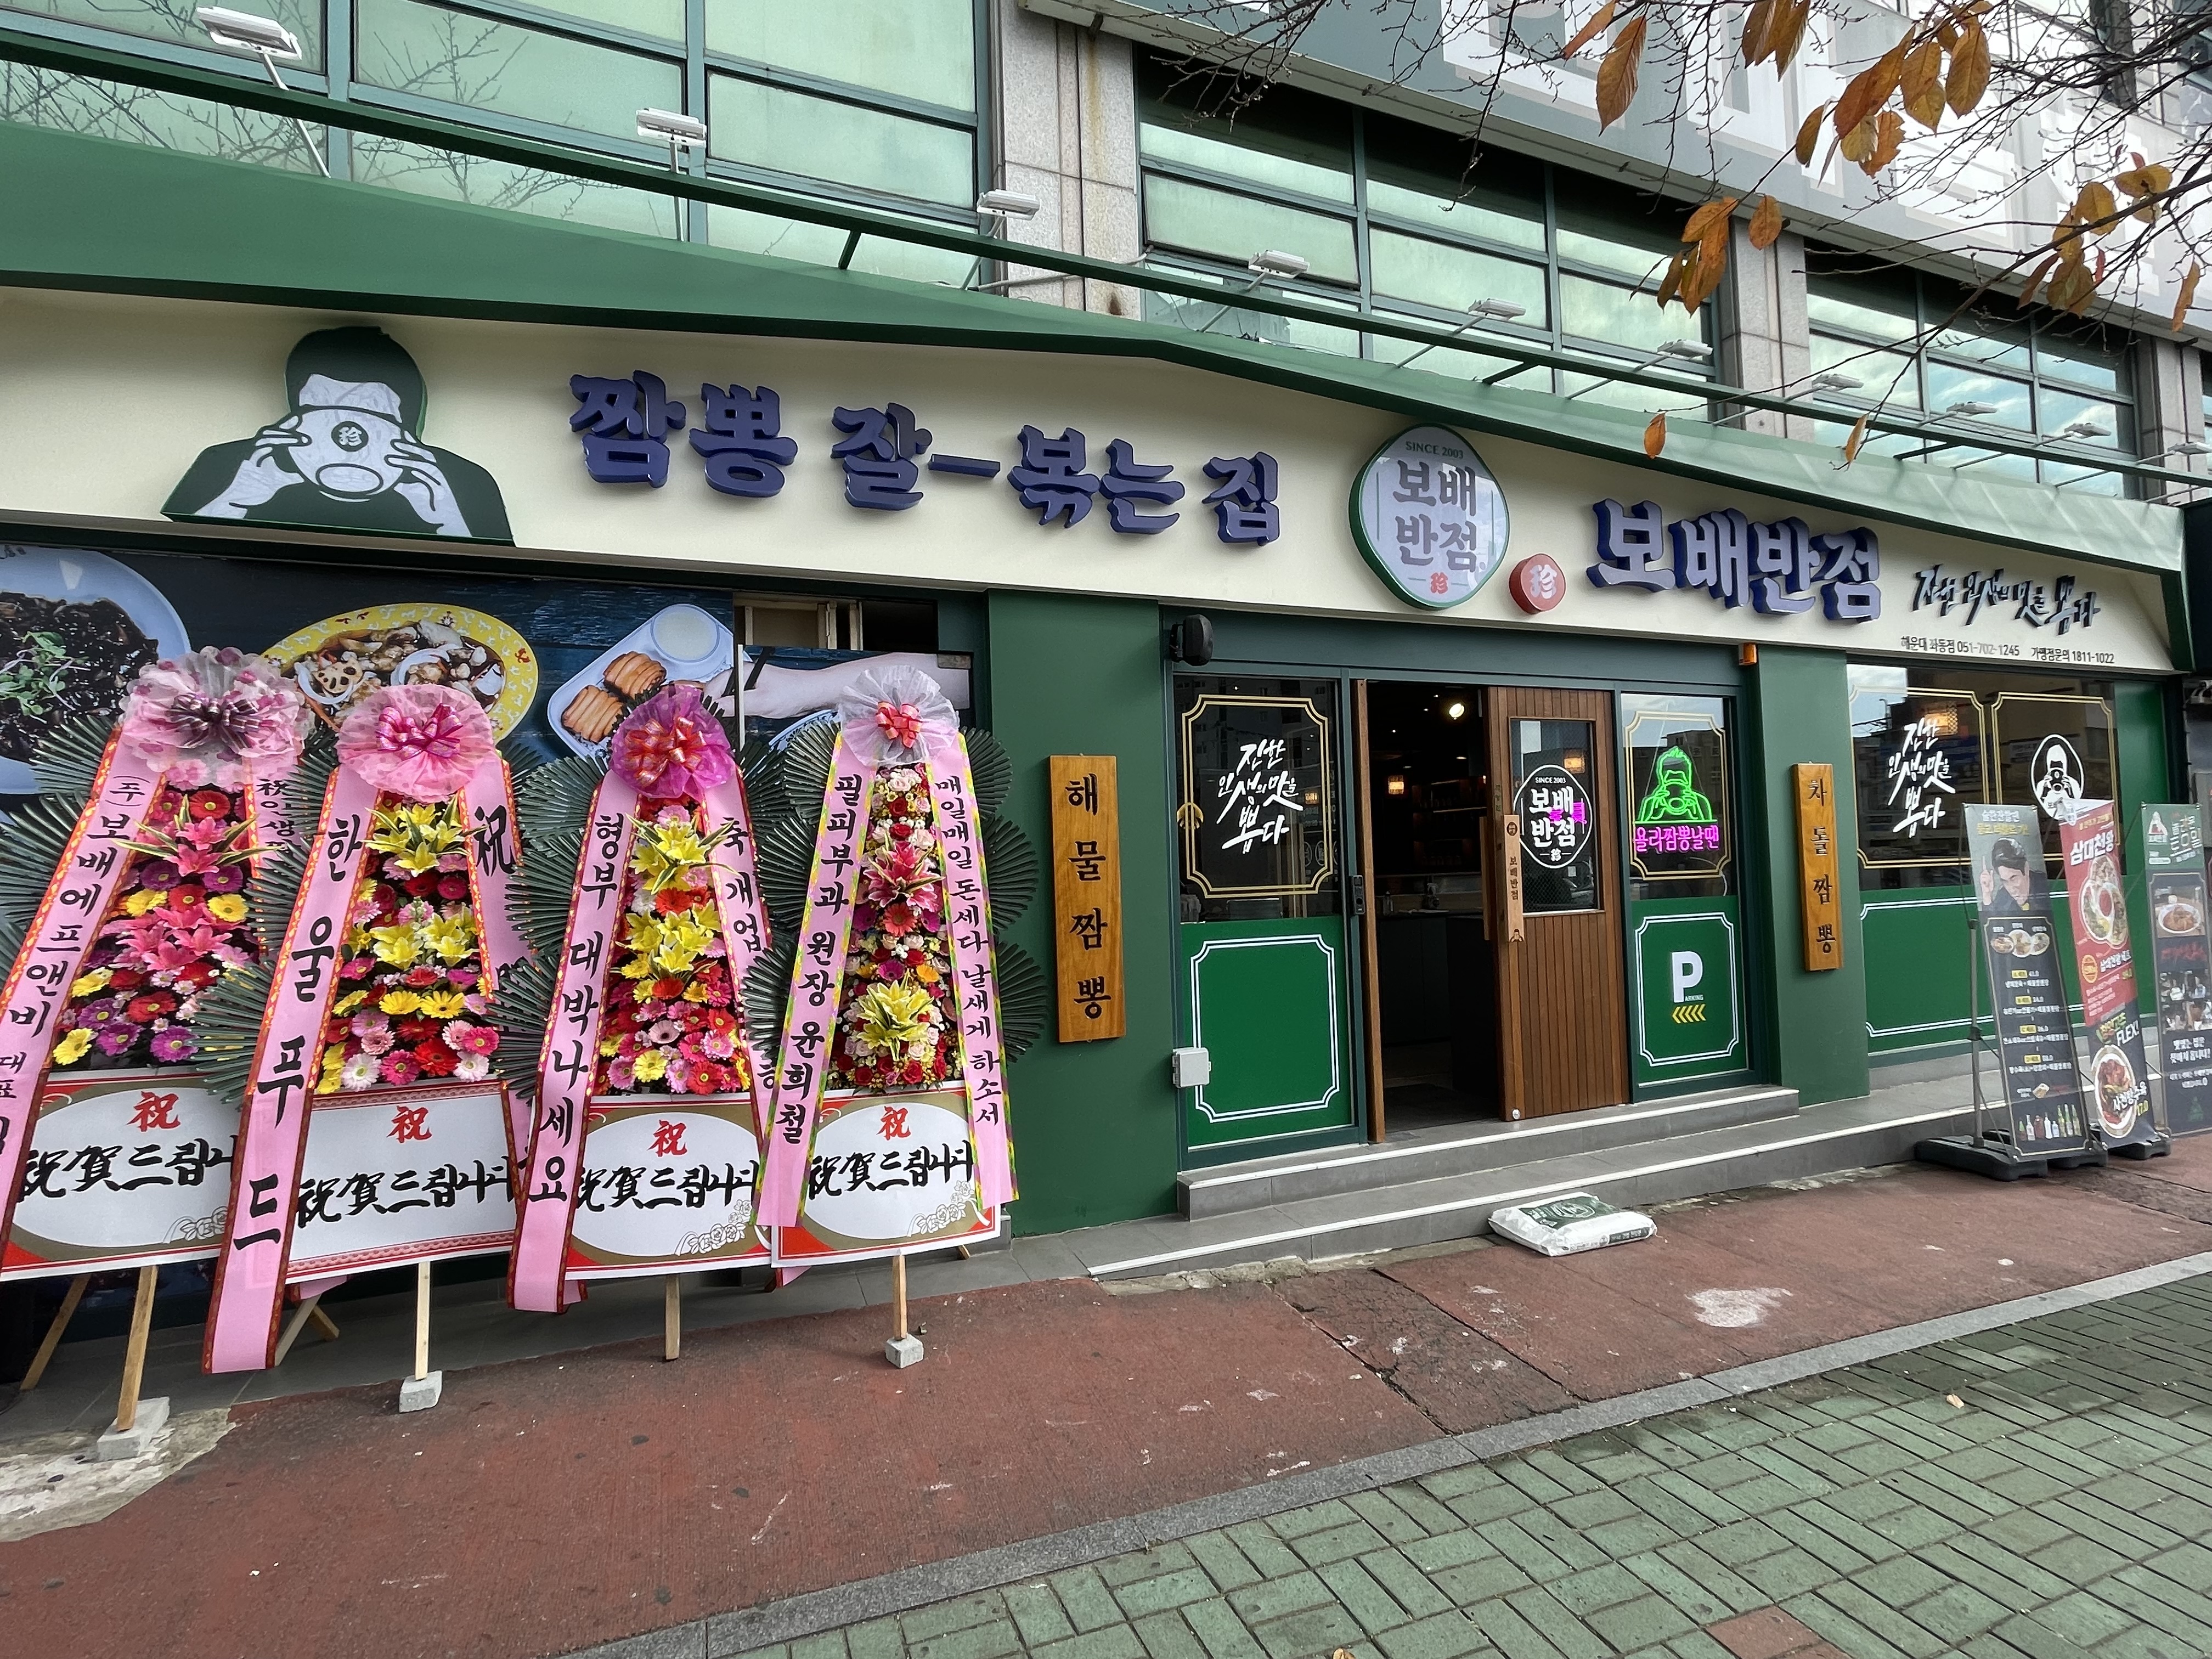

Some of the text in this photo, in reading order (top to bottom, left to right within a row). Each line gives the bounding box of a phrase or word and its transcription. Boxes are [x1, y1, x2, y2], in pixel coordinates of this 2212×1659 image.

[569, 370, 798, 497] 짬뽕
[1201, 452, 1280, 546] 집
[1405, 441, 1464, 460] SINCE 2003
[1393, 460, 1476, 517] 보배
[1395, 514, 1477, 573] 반점
[1586, 498, 1881, 624] 보배반점
[1900, 636, 2114, 664] 해운대 좌동점 051-702-1245 가맹점문의 1811-1022
[1236, 738, 1286, 776] 진한
[1902, 717, 1940, 757] 진한
[1216, 770, 1304, 824] 인생의 맛을
[1529, 786, 1574, 815] 보배
[1888, 751, 1956, 806] 인생의 맛을
[1222, 805, 1290, 854] 볶다
[1531, 816, 1576, 847] 반점
[1893, 786, 1945, 838] 볶다
[474, 804, 516, 877] 祝
[1808, 777, 1837, 954] 차돌짬뽕
[1065, 772, 1111, 1019] 해물짬뽕
[775, 774, 863, 1144] 필피부과 원장 윤희철
[934, 775, 973, 870] 매일매일
[969, 1050, 1002, 1126] 하소서
[233, 813, 364, 1251] 한울푸드
[528, 812, 625, 1202] 형부 대박나세요
[2115, 1020, 2140, 1046] FLEX!
[126, 1091, 181, 1132] 祝
[387, 1105, 433, 1144] 祝
[647, 1119, 688, 1157] 祝
[877, 1105, 911, 1141] 祝
